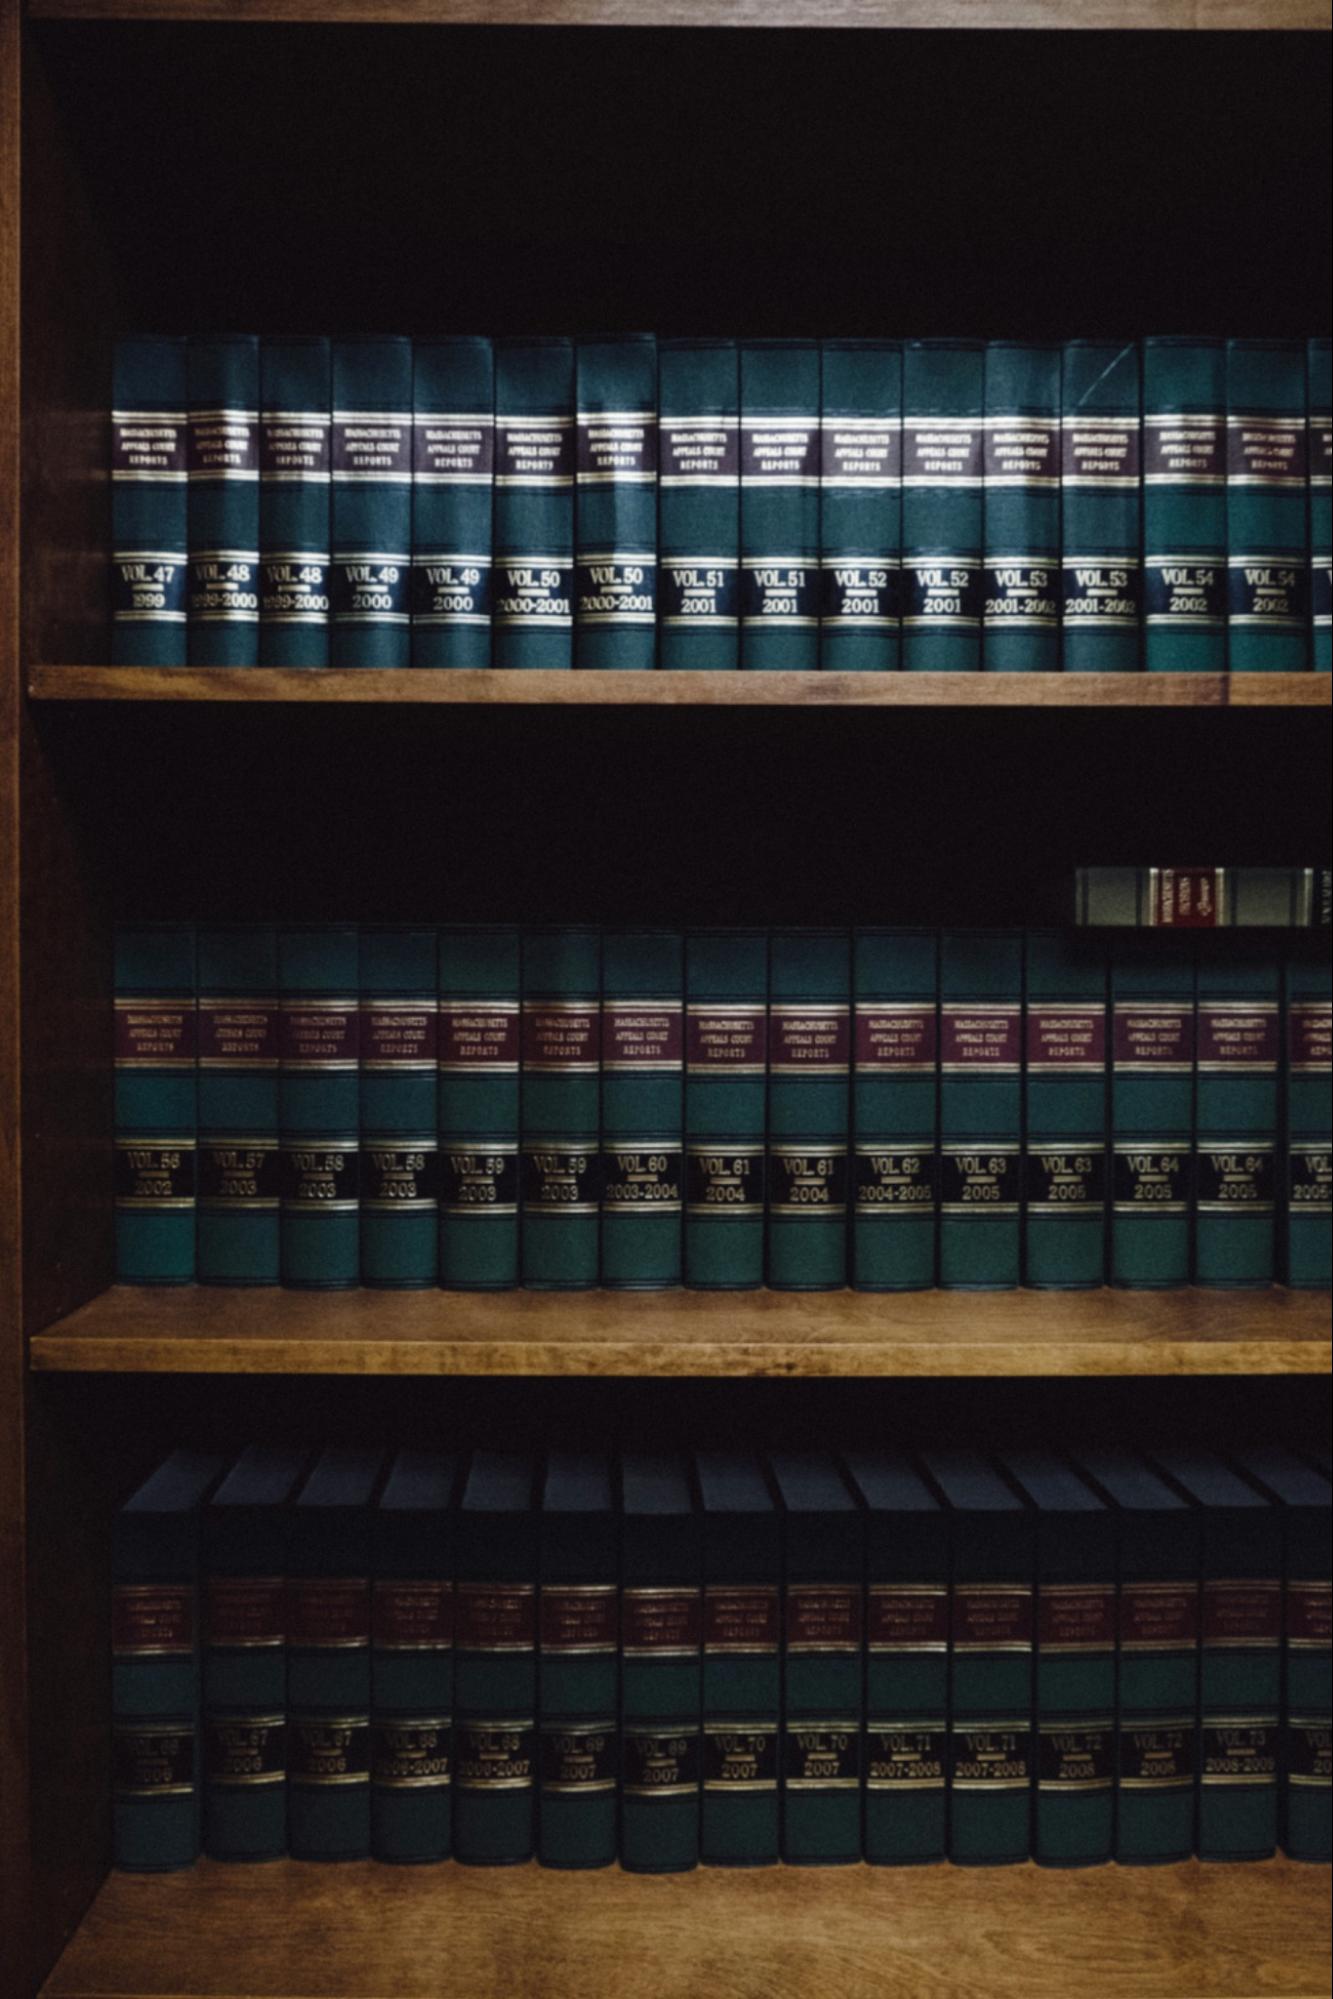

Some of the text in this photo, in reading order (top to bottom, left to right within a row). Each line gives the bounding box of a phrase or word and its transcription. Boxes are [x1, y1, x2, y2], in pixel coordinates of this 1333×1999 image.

[132, 594, 165, 608] 1999
[352, 595, 391, 610] 2000
[433, 596, 473, 611] 2000
[681, 599, 717, 613] 2001
[762, 599, 797, 614] 2001
[842, 599, 880, 614] 2001
[923, 597, 961, 613] 2001
[1169, 596, 1207, 612] 2002
[1253, 597, 1289, 612] 2002
[135, 1181, 172, 1195] 2002
[220, 1181, 257, 1194] 2003
[299, 1184, 336, 1197] 2003
[379, 1183, 416, 1197] 2003
[458, 1187, 496, 1201] 2003
[542, 1186, 579, 1200] 2003
[706, 1188, 745, 1201] 2004
[962, 1186, 1000, 1200] 2005
[1048, 1185, 1086, 1200] 2005
[1134, 1185, 1172, 1200] 2005
[1219, 1185, 1257, 1200] 2005
[790, 1188, 828, 1202] 2004
